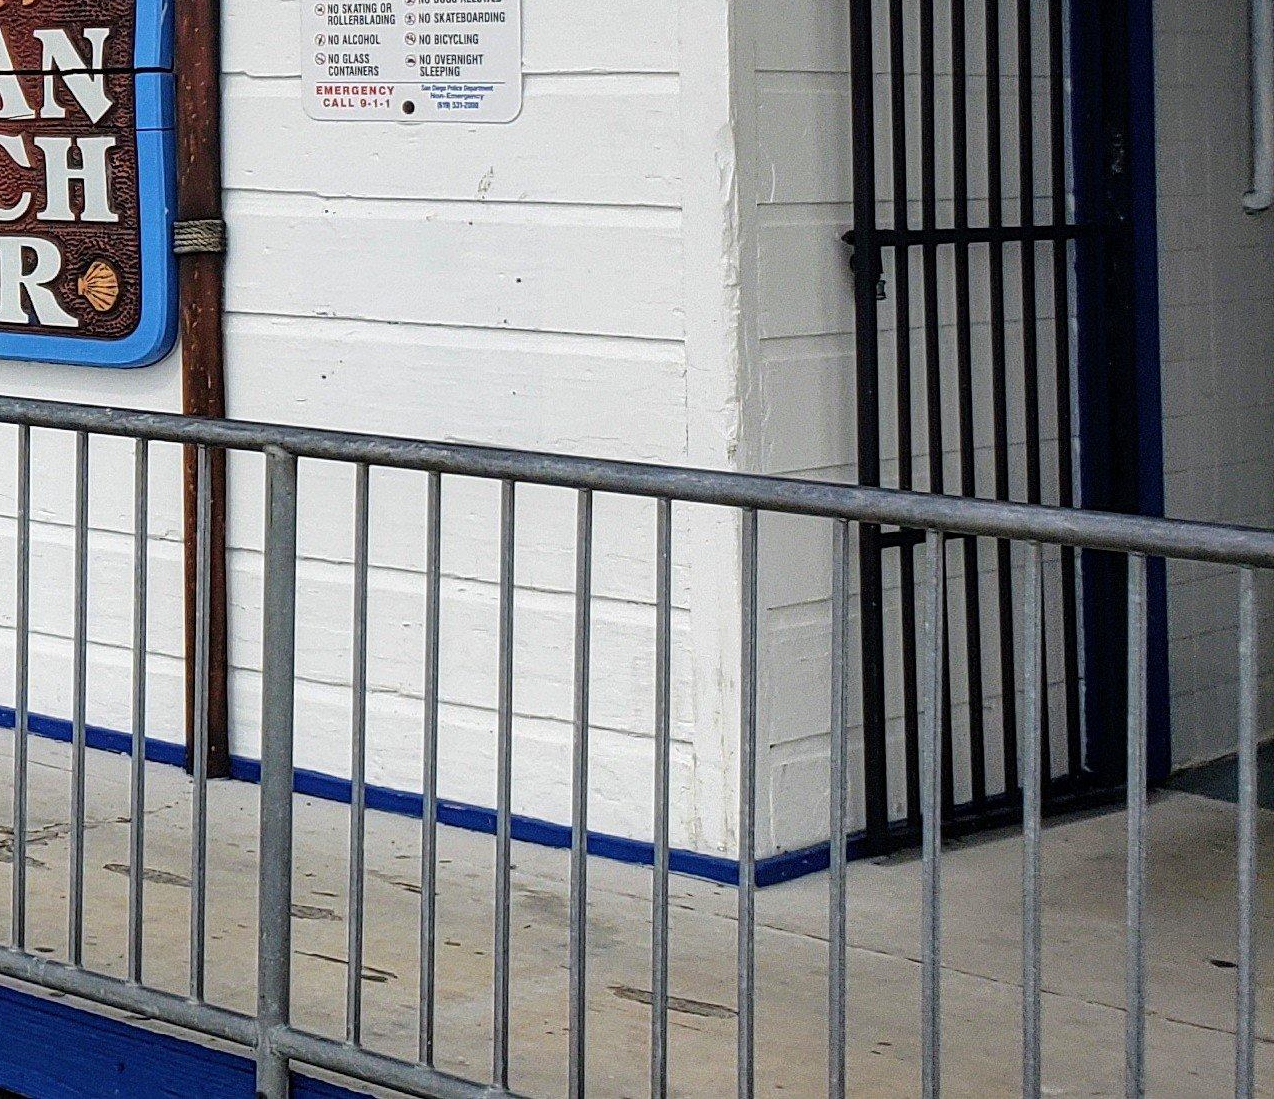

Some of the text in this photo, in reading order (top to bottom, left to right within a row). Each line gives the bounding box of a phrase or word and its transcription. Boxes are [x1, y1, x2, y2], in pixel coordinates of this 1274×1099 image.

[328, 3, 392, 14] NO SKATING OR
[328, 15, 396, 25] ROLLERBLADING
[419, 12, 505, 23] NO SKATEBOARDING
[328, 34, 381, 45] NO ALCOHOL
[419, 34, 479, 45] NO BICYCLING
[328, 53, 370, 64] NO GLASS
[419, 54, 484, 65] NO OVERNIGHT
[328, 66, 379, 76] CONTAINERS
[420, 66, 460, 77] SLEEPING
[316, 86, 395, 95] EMERGENCY
[323, 98, 391, 108] CALL 9-1-1
